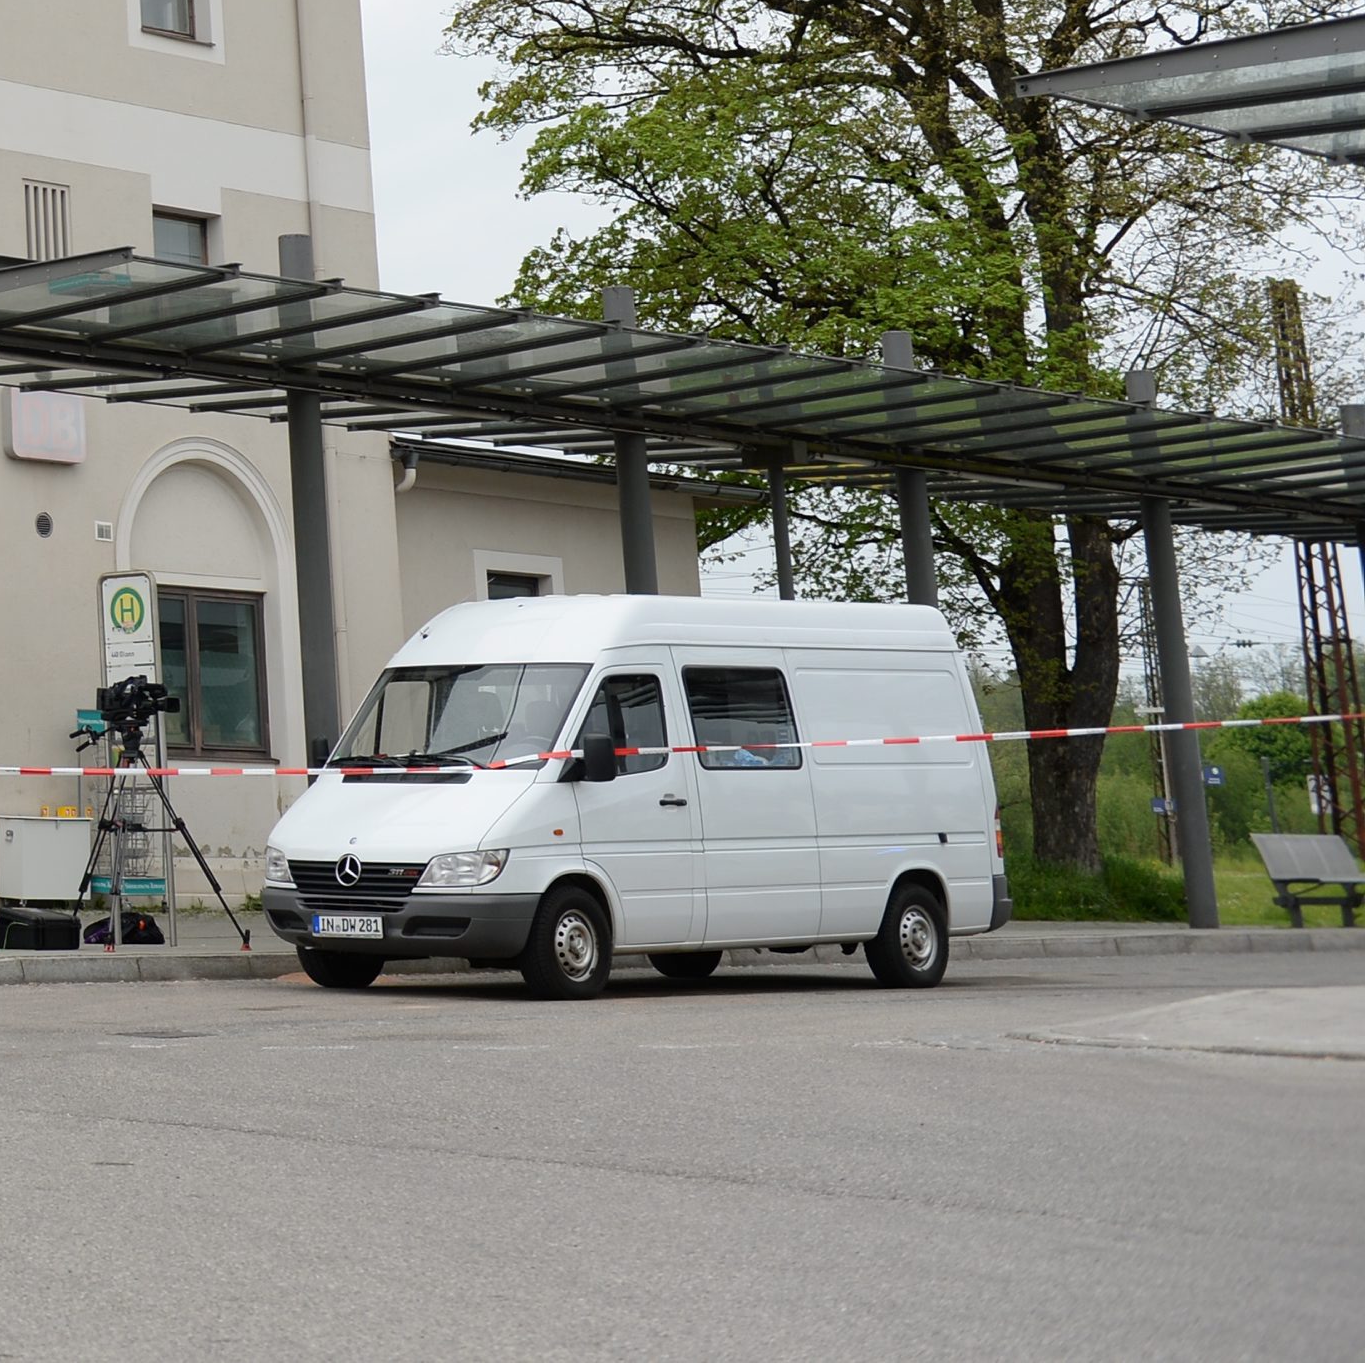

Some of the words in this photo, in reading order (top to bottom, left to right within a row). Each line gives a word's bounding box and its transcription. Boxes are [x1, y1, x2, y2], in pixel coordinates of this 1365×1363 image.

[120, 597, 134, 623] H
[321, 918, 334, 932] IN
[342, 918, 356, 932] DW
[359, 918, 380, 933] 281
